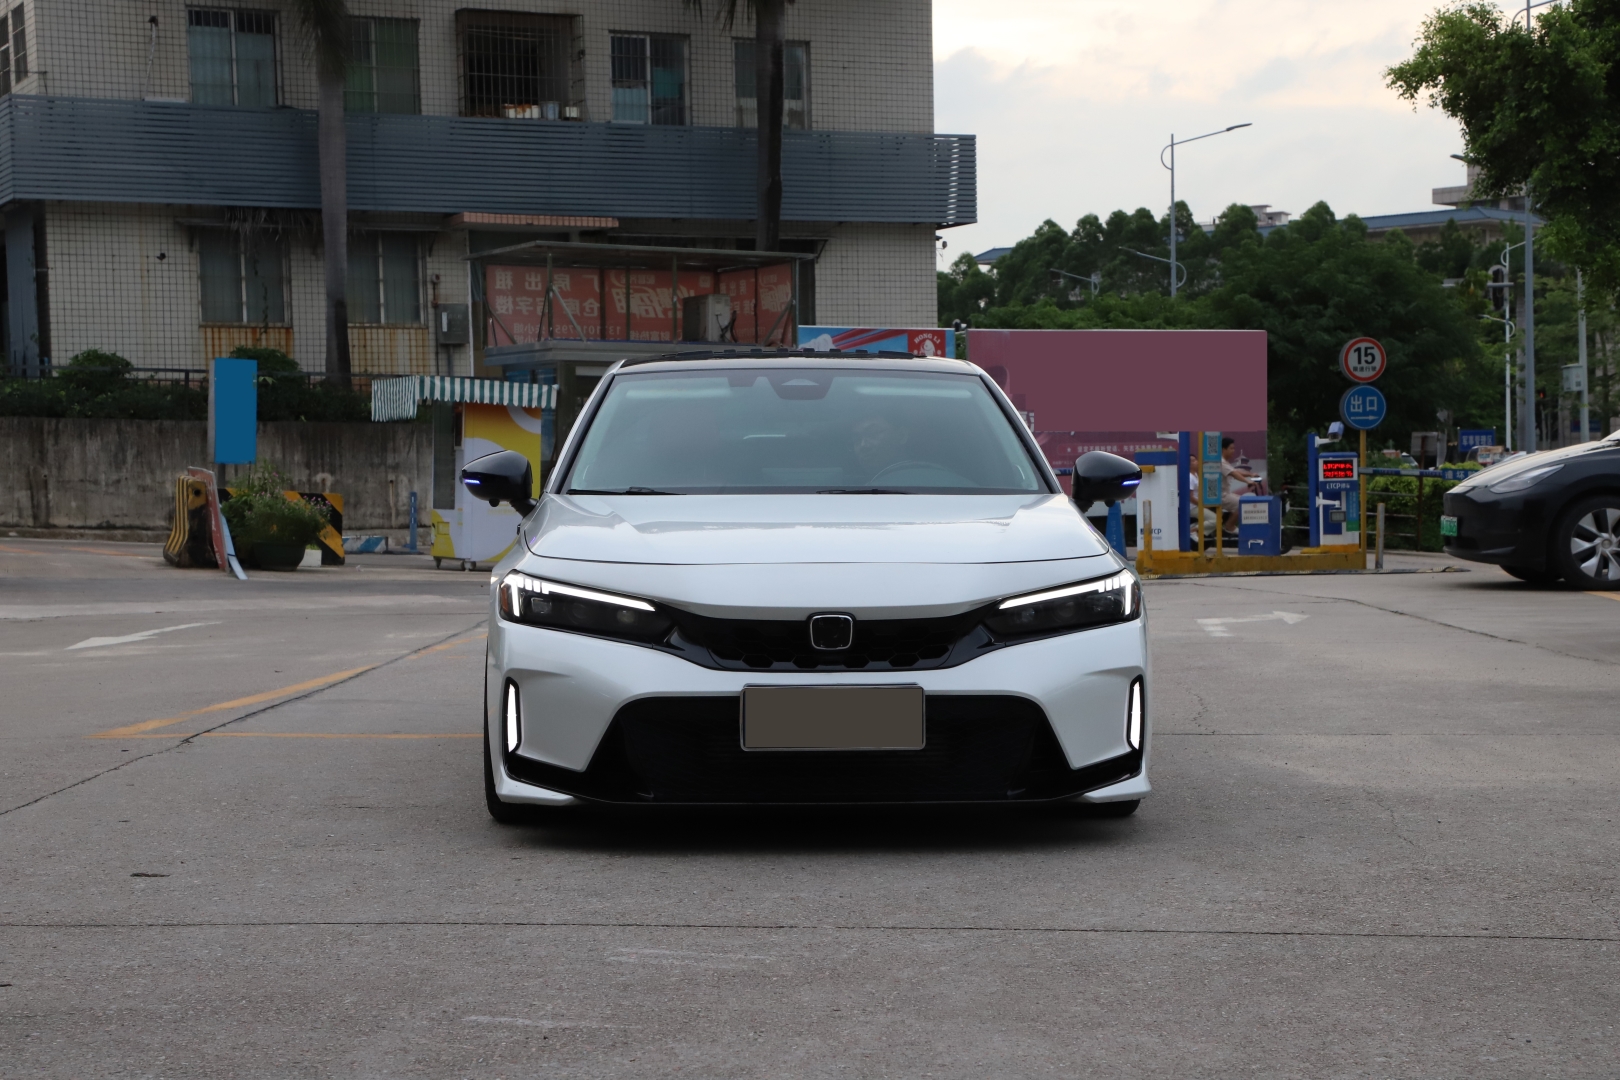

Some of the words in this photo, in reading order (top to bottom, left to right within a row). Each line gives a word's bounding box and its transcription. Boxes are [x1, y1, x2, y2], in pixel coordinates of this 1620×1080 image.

[914, 333, 933, 343] HONG
[933, 336, 941, 344] LI
[1353, 347, 1376, 365] 15
[1350, 395, 1377, 412] 出口
